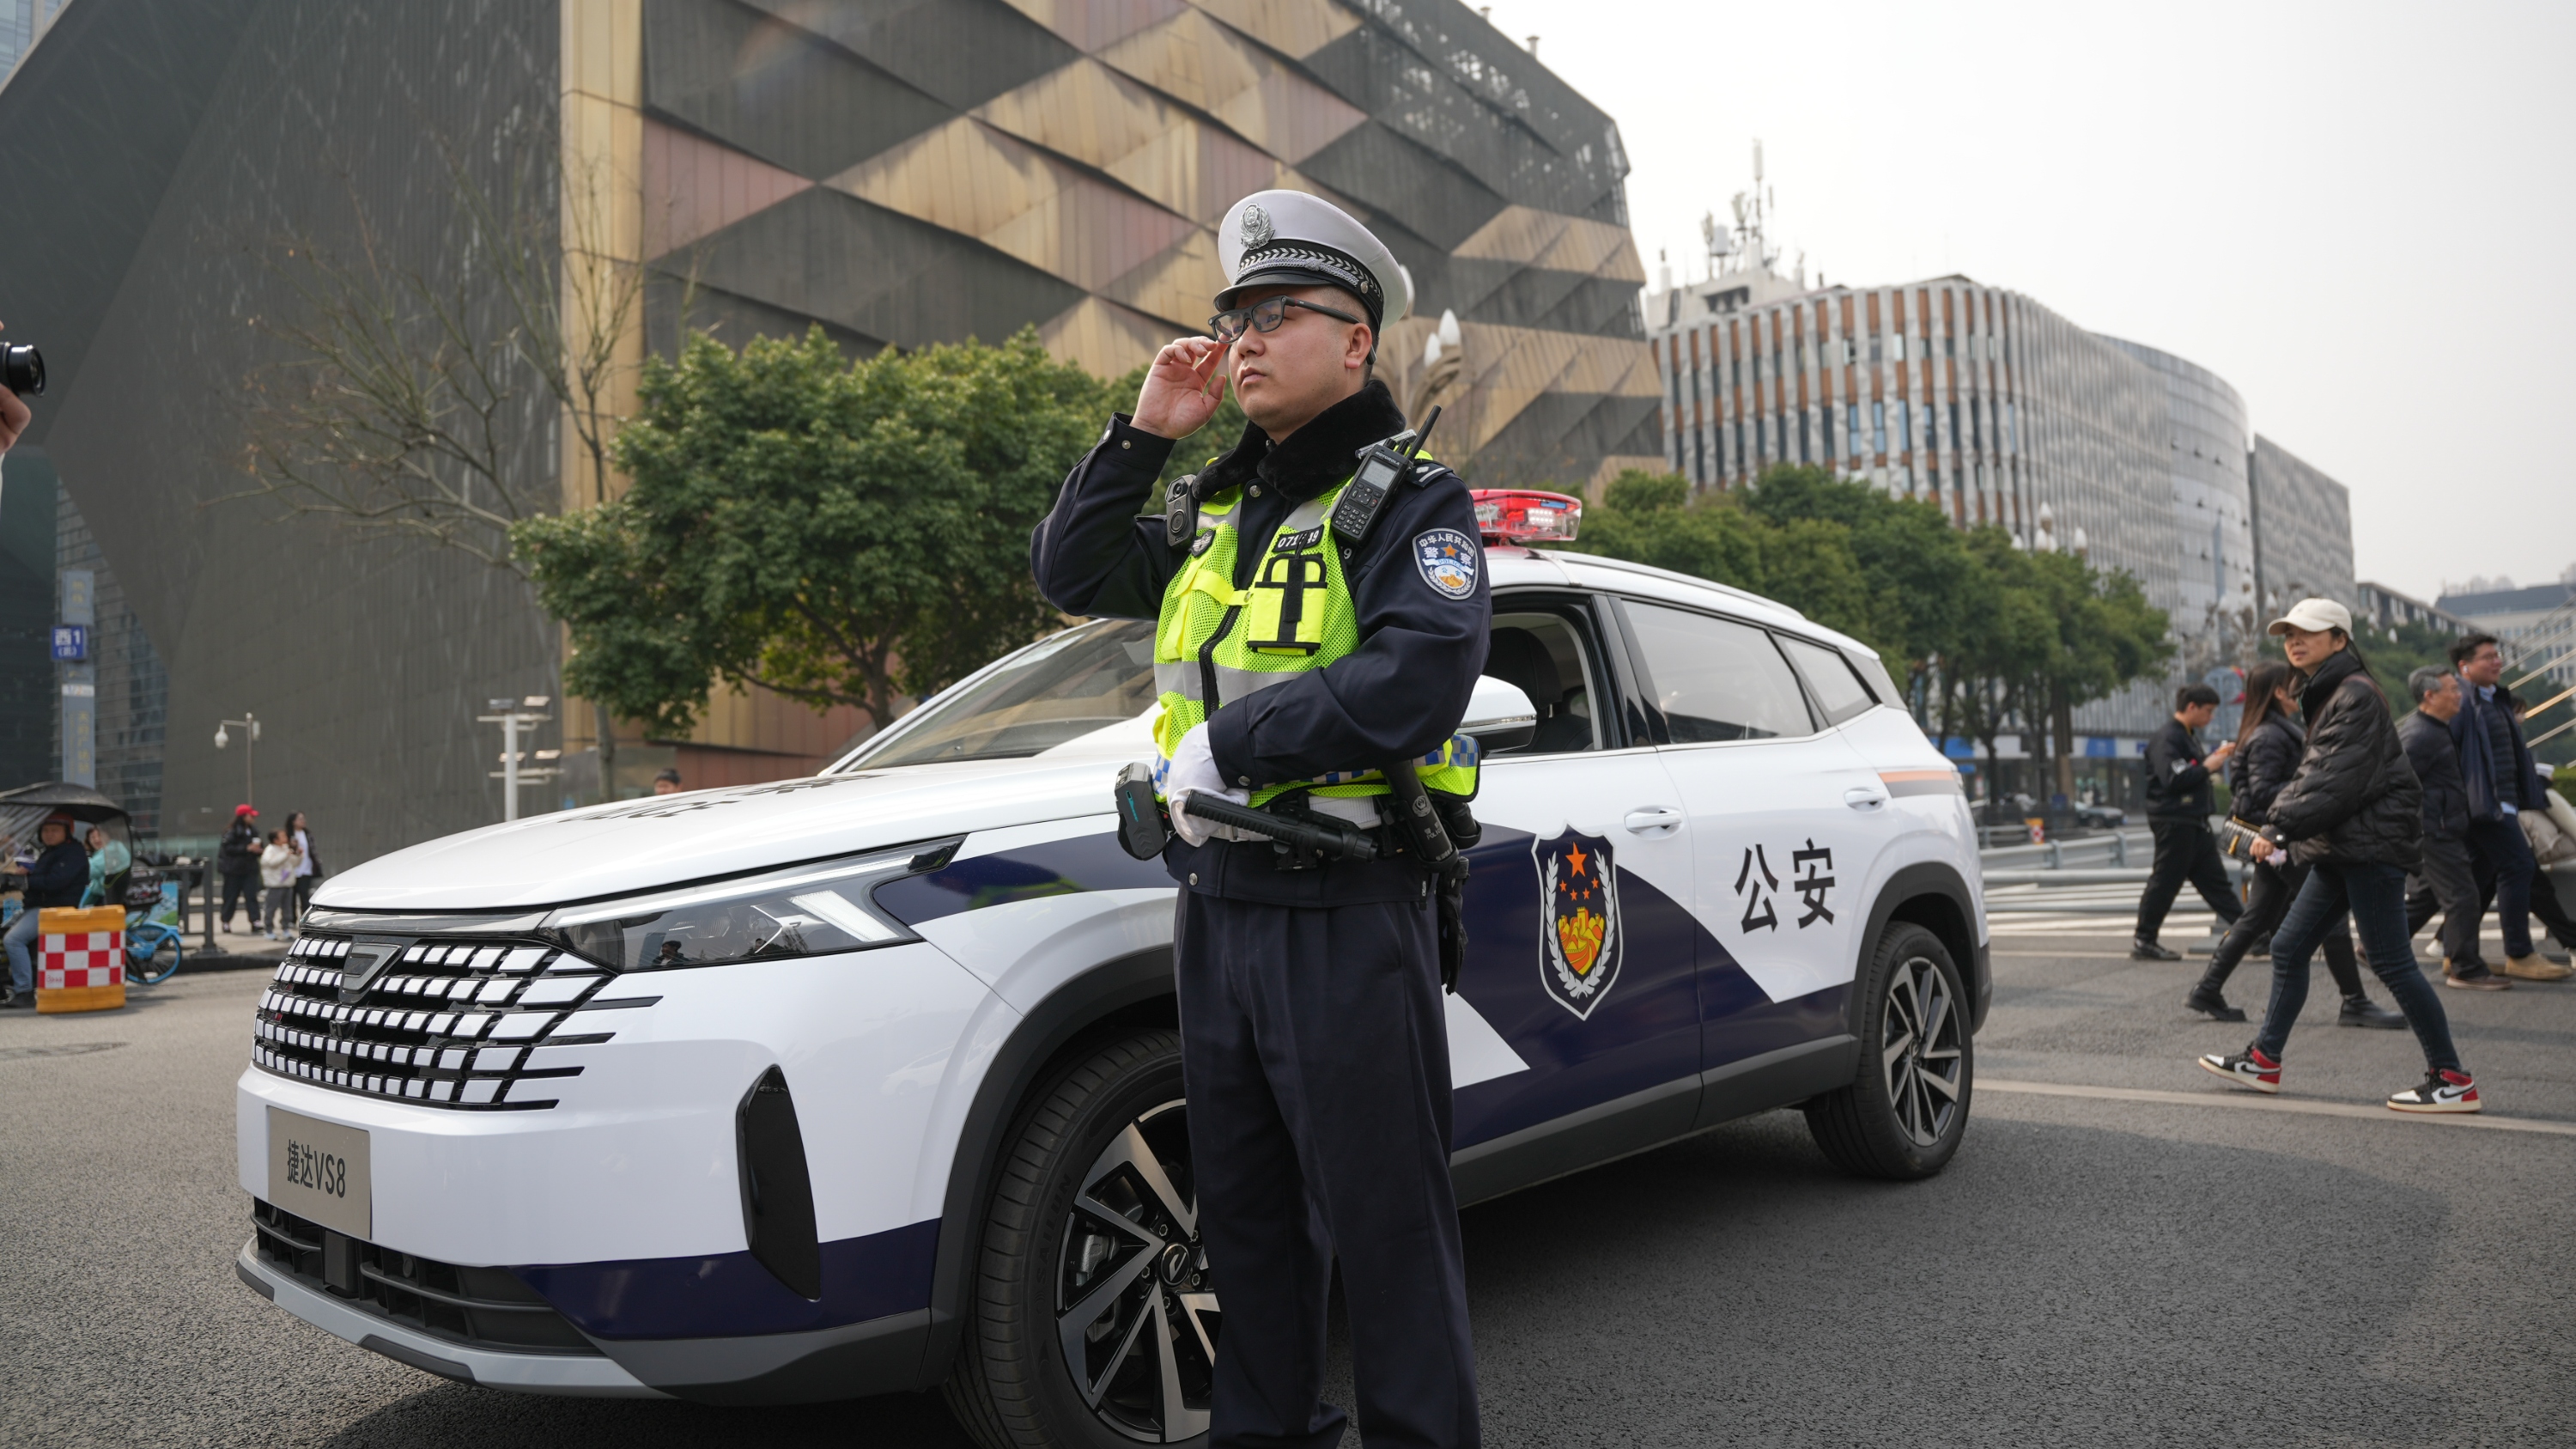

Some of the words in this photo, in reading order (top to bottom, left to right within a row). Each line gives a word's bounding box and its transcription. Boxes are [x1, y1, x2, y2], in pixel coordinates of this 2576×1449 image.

[1375, 451, 1400, 466] MOTOROLA
[1419, 533, 1475, 557] 中华人民共和国
[1424, 546, 1473, 567] 警察
[1733, 837, 1836, 935] 公安
[287, 1138, 346, 1198] 捷达VS8
[1036, 1172, 1072, 1285] SAILUN
